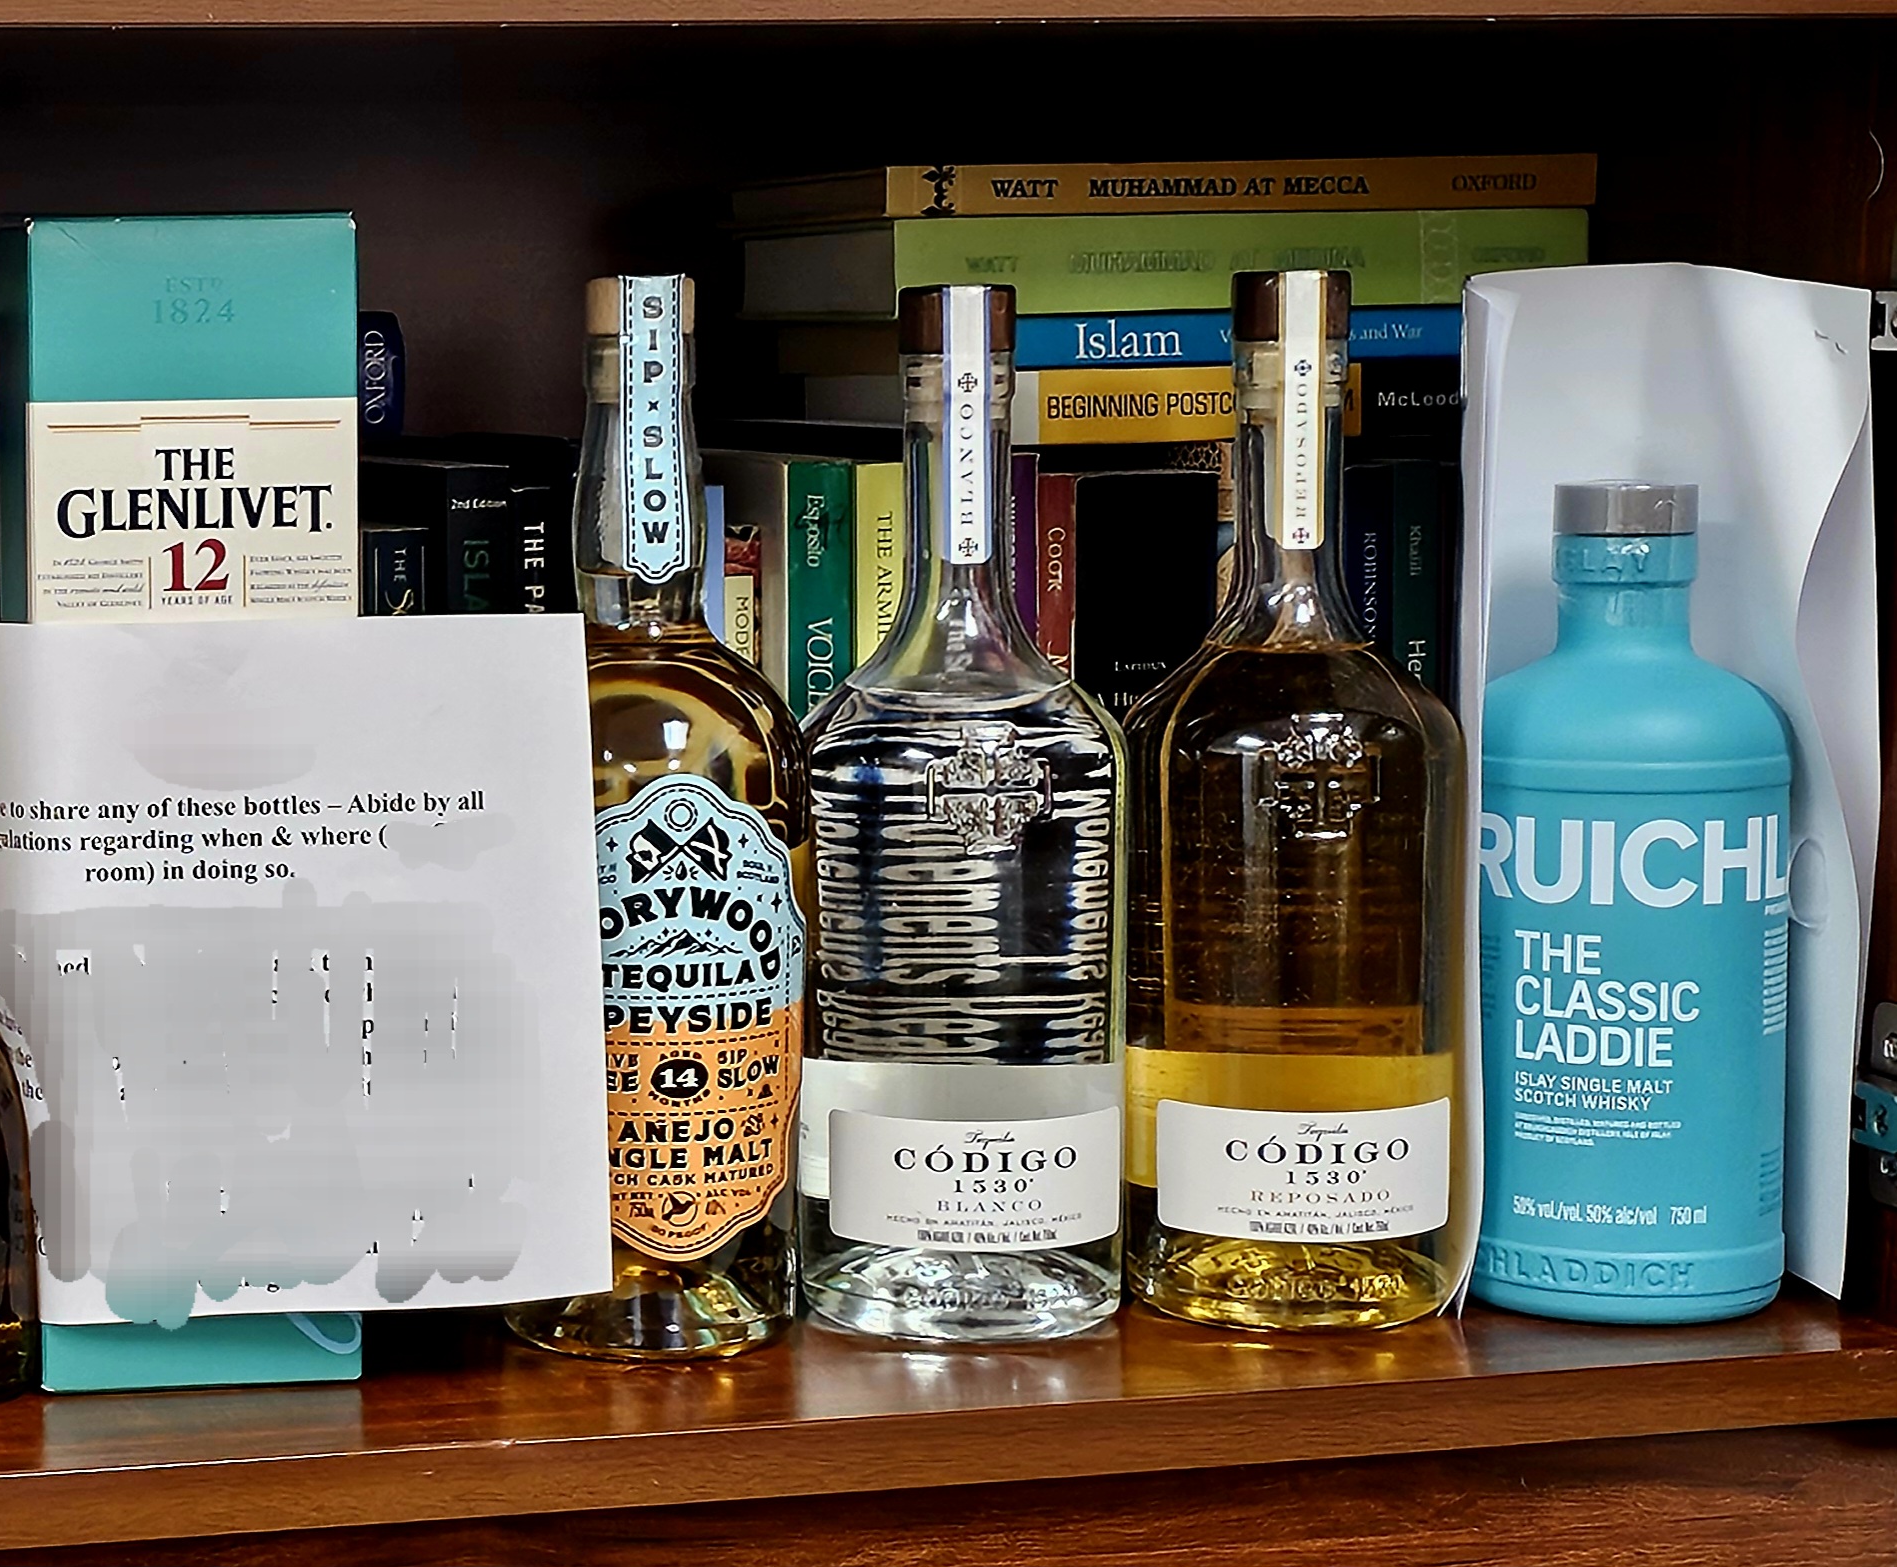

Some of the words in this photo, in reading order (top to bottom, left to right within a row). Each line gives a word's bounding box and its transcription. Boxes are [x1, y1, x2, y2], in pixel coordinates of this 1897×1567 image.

[991, 178, 1059, 198] WATT
[1088, 177, 1237, 198] MUHAMMAD
[1243, 177, 1276, 196] AT
[1283, 175, 1370, 196] MECCA
[1451, 173, 1537, 191] OXFORD
[965, 255, 1019, 273] WATT
[154, 299, 236, 324] 1824
[642, 296, 665, 384] SIP
[1075, 318, 1183, 360] Islam
[1391, 322, 1423, 340] War
[363, 330, 386, 424] OXFORD
[1047, 392, 1159, 420] BEGINNING
[154, 447, 235, 481] THE
[960, 402, 975, 526] BLANCO
[642, 425, 670, 545] SLOW
[524, 521, 546, 570] THE
[876, 510, 893, 559] THE
[162, 538, 231, 592] 12
[1046, 526, 1067, 592] COOK
[213, 596, 233, 605] AGE
[1363, 532, 1378, 639] ROBINSON
[10, 801, 24, 819] to
[29, 800, 90, 820] share
[98, 803, 139, 823] any
[147, 798, 172, 818] of
[176, 796, 236, 818] these
[243, 794, 321, 817] bottles
[347, 792, 417, 815] Abide
[422, 791, 451, 819] by
[457, 791, 485, 812] all
[80, 829, 194, 856] regarding
[201, 827, 263, 848] when
[271, 826, 292, 847] &
[301, 825, 372, 848] where
[84, 861, 155, 885] room)
[163, 860, 184, 882] in
[192, 858, 257, 884] doing
[265, 862, 296, 880] so.
[1514, 929, 1602, 976] THE
[602, 959, 757, 993] TEQUILA
[1515, 974, 1701, 1023] CLASSIC
[717, 1048, 748, 1065] SIP
[1515, 1019, 1674, 1068] LADDIE
[659, 1067, 700, 1089] 14
[717, 1054, 781, 1089] SLOW
[1514, 1070, 1557, 1088] ISLAY
[1560, 1076, 1621, 1094] SINGLE
[1626, 1079, 1674, 1095] MALT
[1514, 1087, 1577, 1108] SCOTCH
[1581, 1094, 1652, 1112] WHISKY
[702, 1137, 773, 1168] MALT
[893, 1143, 1079, 1174] CÓDIGO
[1225, 1134, 1410, 1165] CÓDIGO
[647, 1173, 697, 1186] CASK
[703, 1162, 774, 1184] MATURED
[937, 1199, 1043, 1213] BLANCO
[1251, 1188, 1391, 1204] REPOSADO
[1586, 1204, 1613, 1224] 50%
[1615, 1205, 1658, 1225] alc/vol
[1670, 1205, 1692, 1225] 750
